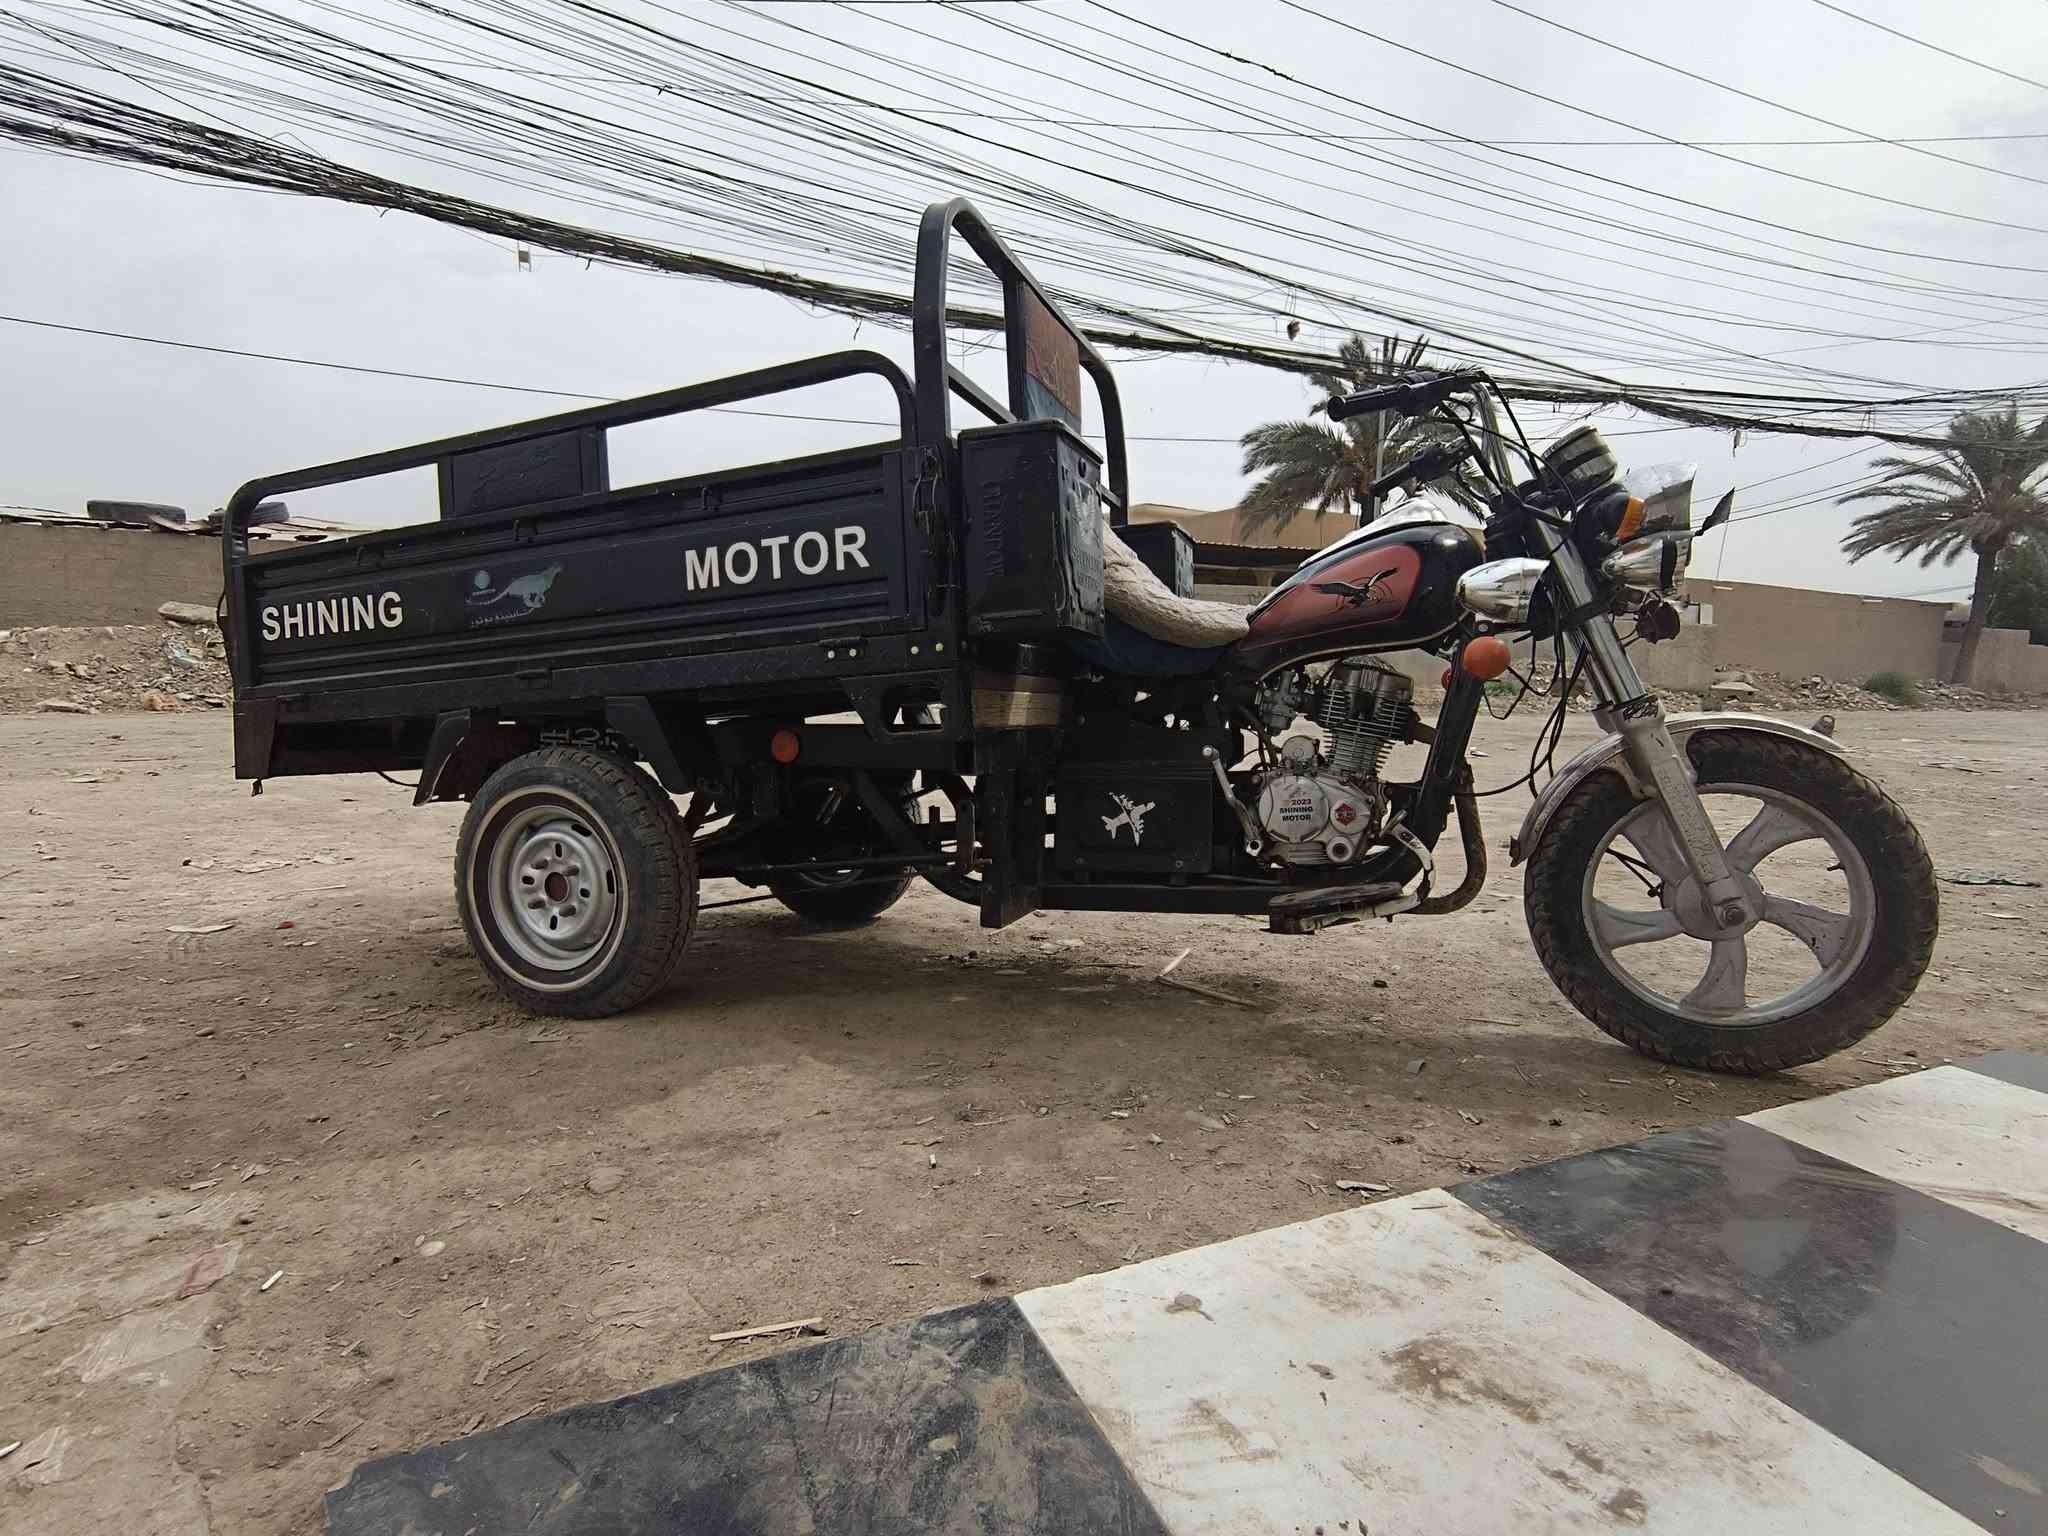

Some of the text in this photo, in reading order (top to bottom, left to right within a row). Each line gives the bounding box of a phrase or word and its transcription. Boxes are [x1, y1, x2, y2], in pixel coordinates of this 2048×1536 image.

[262, 525, 870, 641] SHINING MOTOR
[1282, 814, 1312, 822] MOTOR
